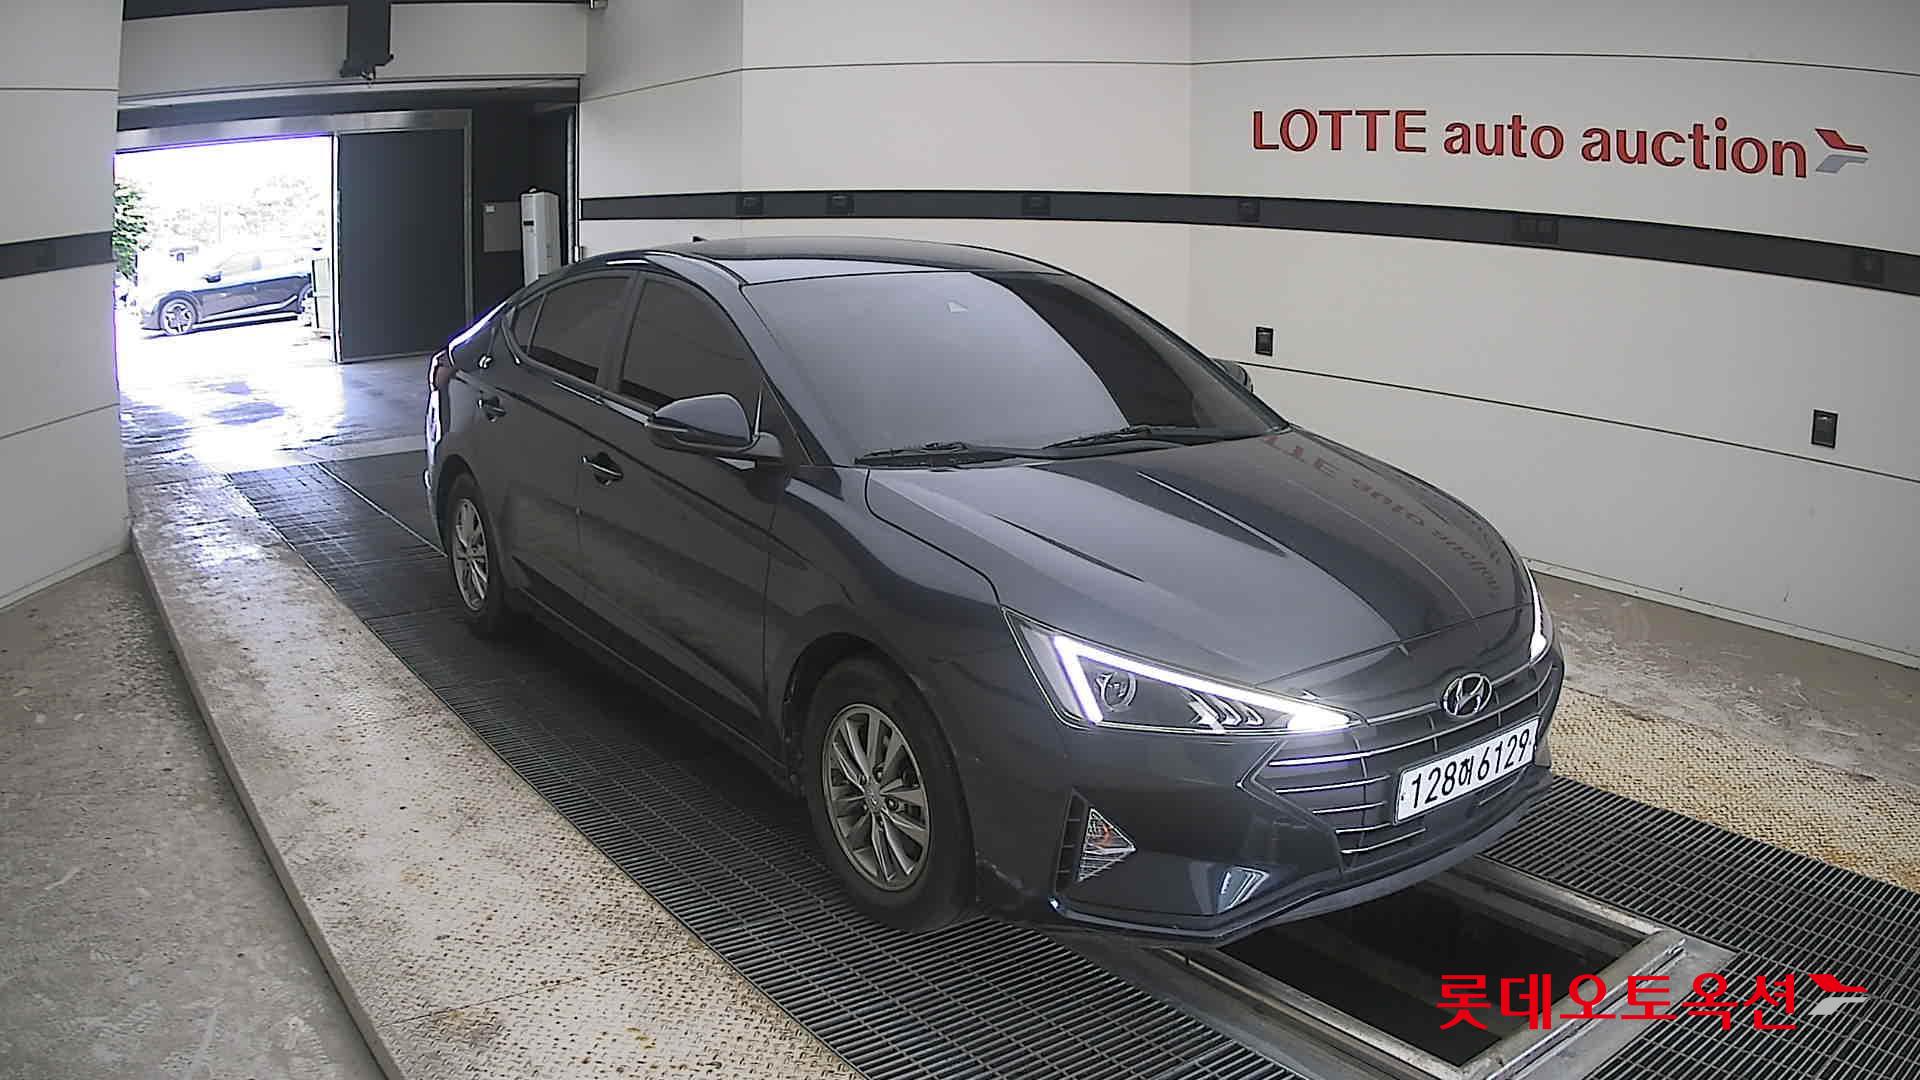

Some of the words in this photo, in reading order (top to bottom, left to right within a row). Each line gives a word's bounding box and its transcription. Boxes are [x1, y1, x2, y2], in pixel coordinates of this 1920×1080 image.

[1252, 109, 1427, 153] LOTTE
[1443, 114, 1566, 160] auto
[1580, 117, 1808, 178] auction
